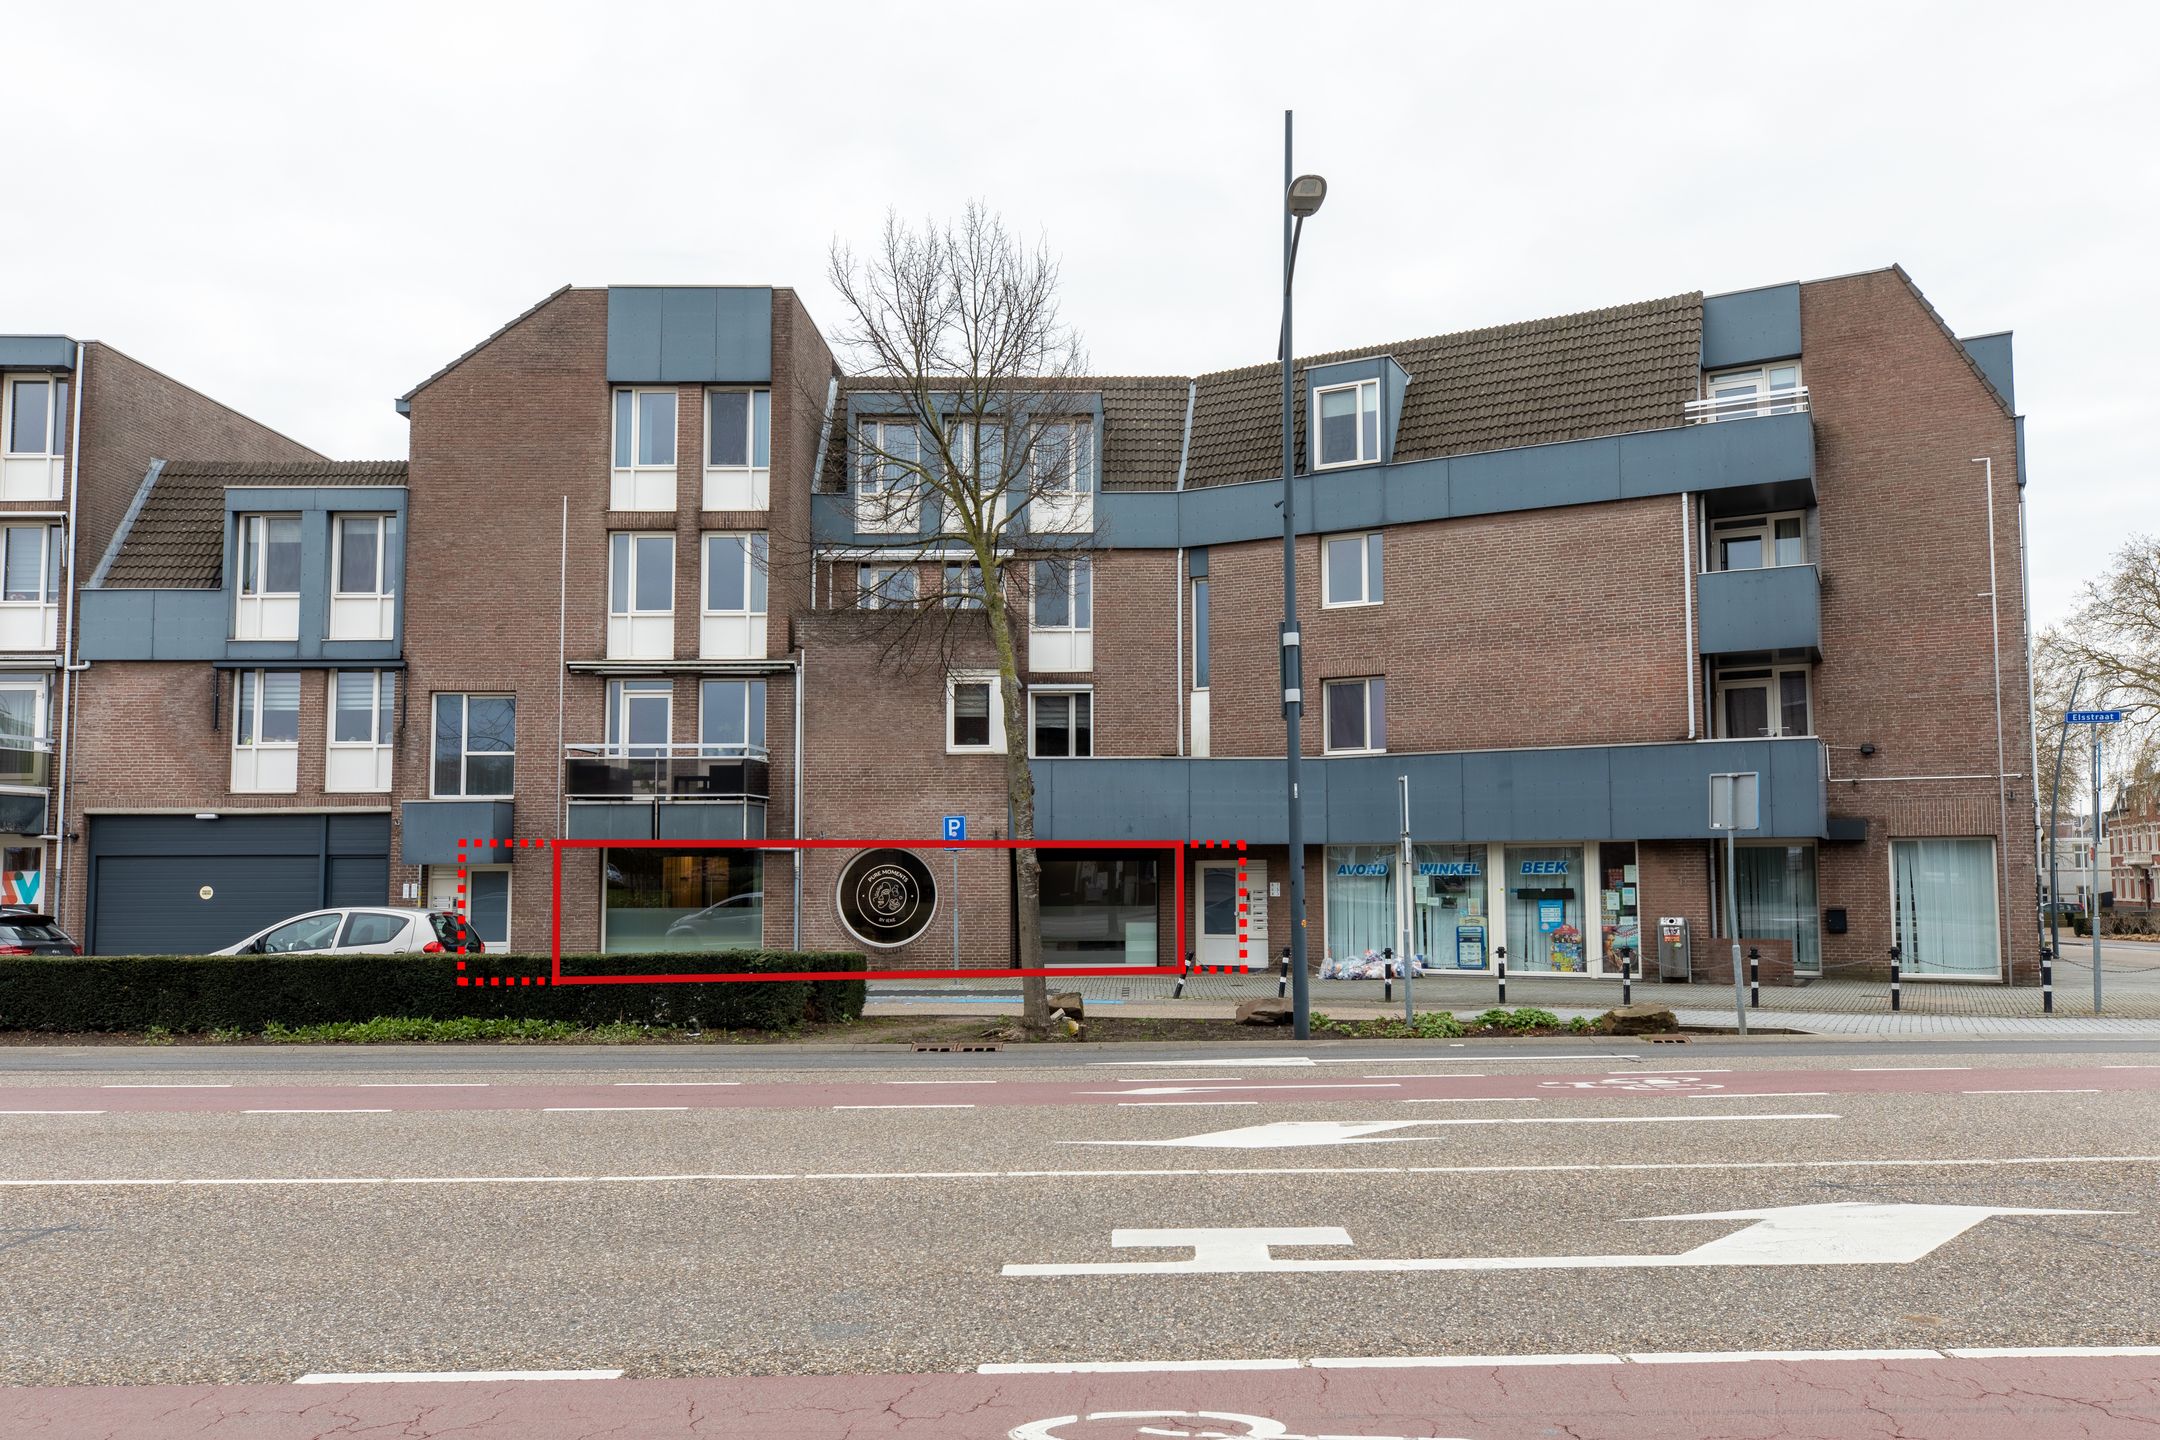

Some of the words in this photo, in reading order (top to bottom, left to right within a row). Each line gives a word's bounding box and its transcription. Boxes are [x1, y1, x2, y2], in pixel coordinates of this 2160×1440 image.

[2072, 713, 2114, 721] Elsstraat
[948, 819, 960, 836] P
[1336, 863, 1389, 876] AVOND
[1418, 862, 1481, 876] WINKEL
[1519, 861, 1569, 875] BEEK
[867, 870, 882, 883] PURE
[881, 869, 909, 883] MOMENTS
